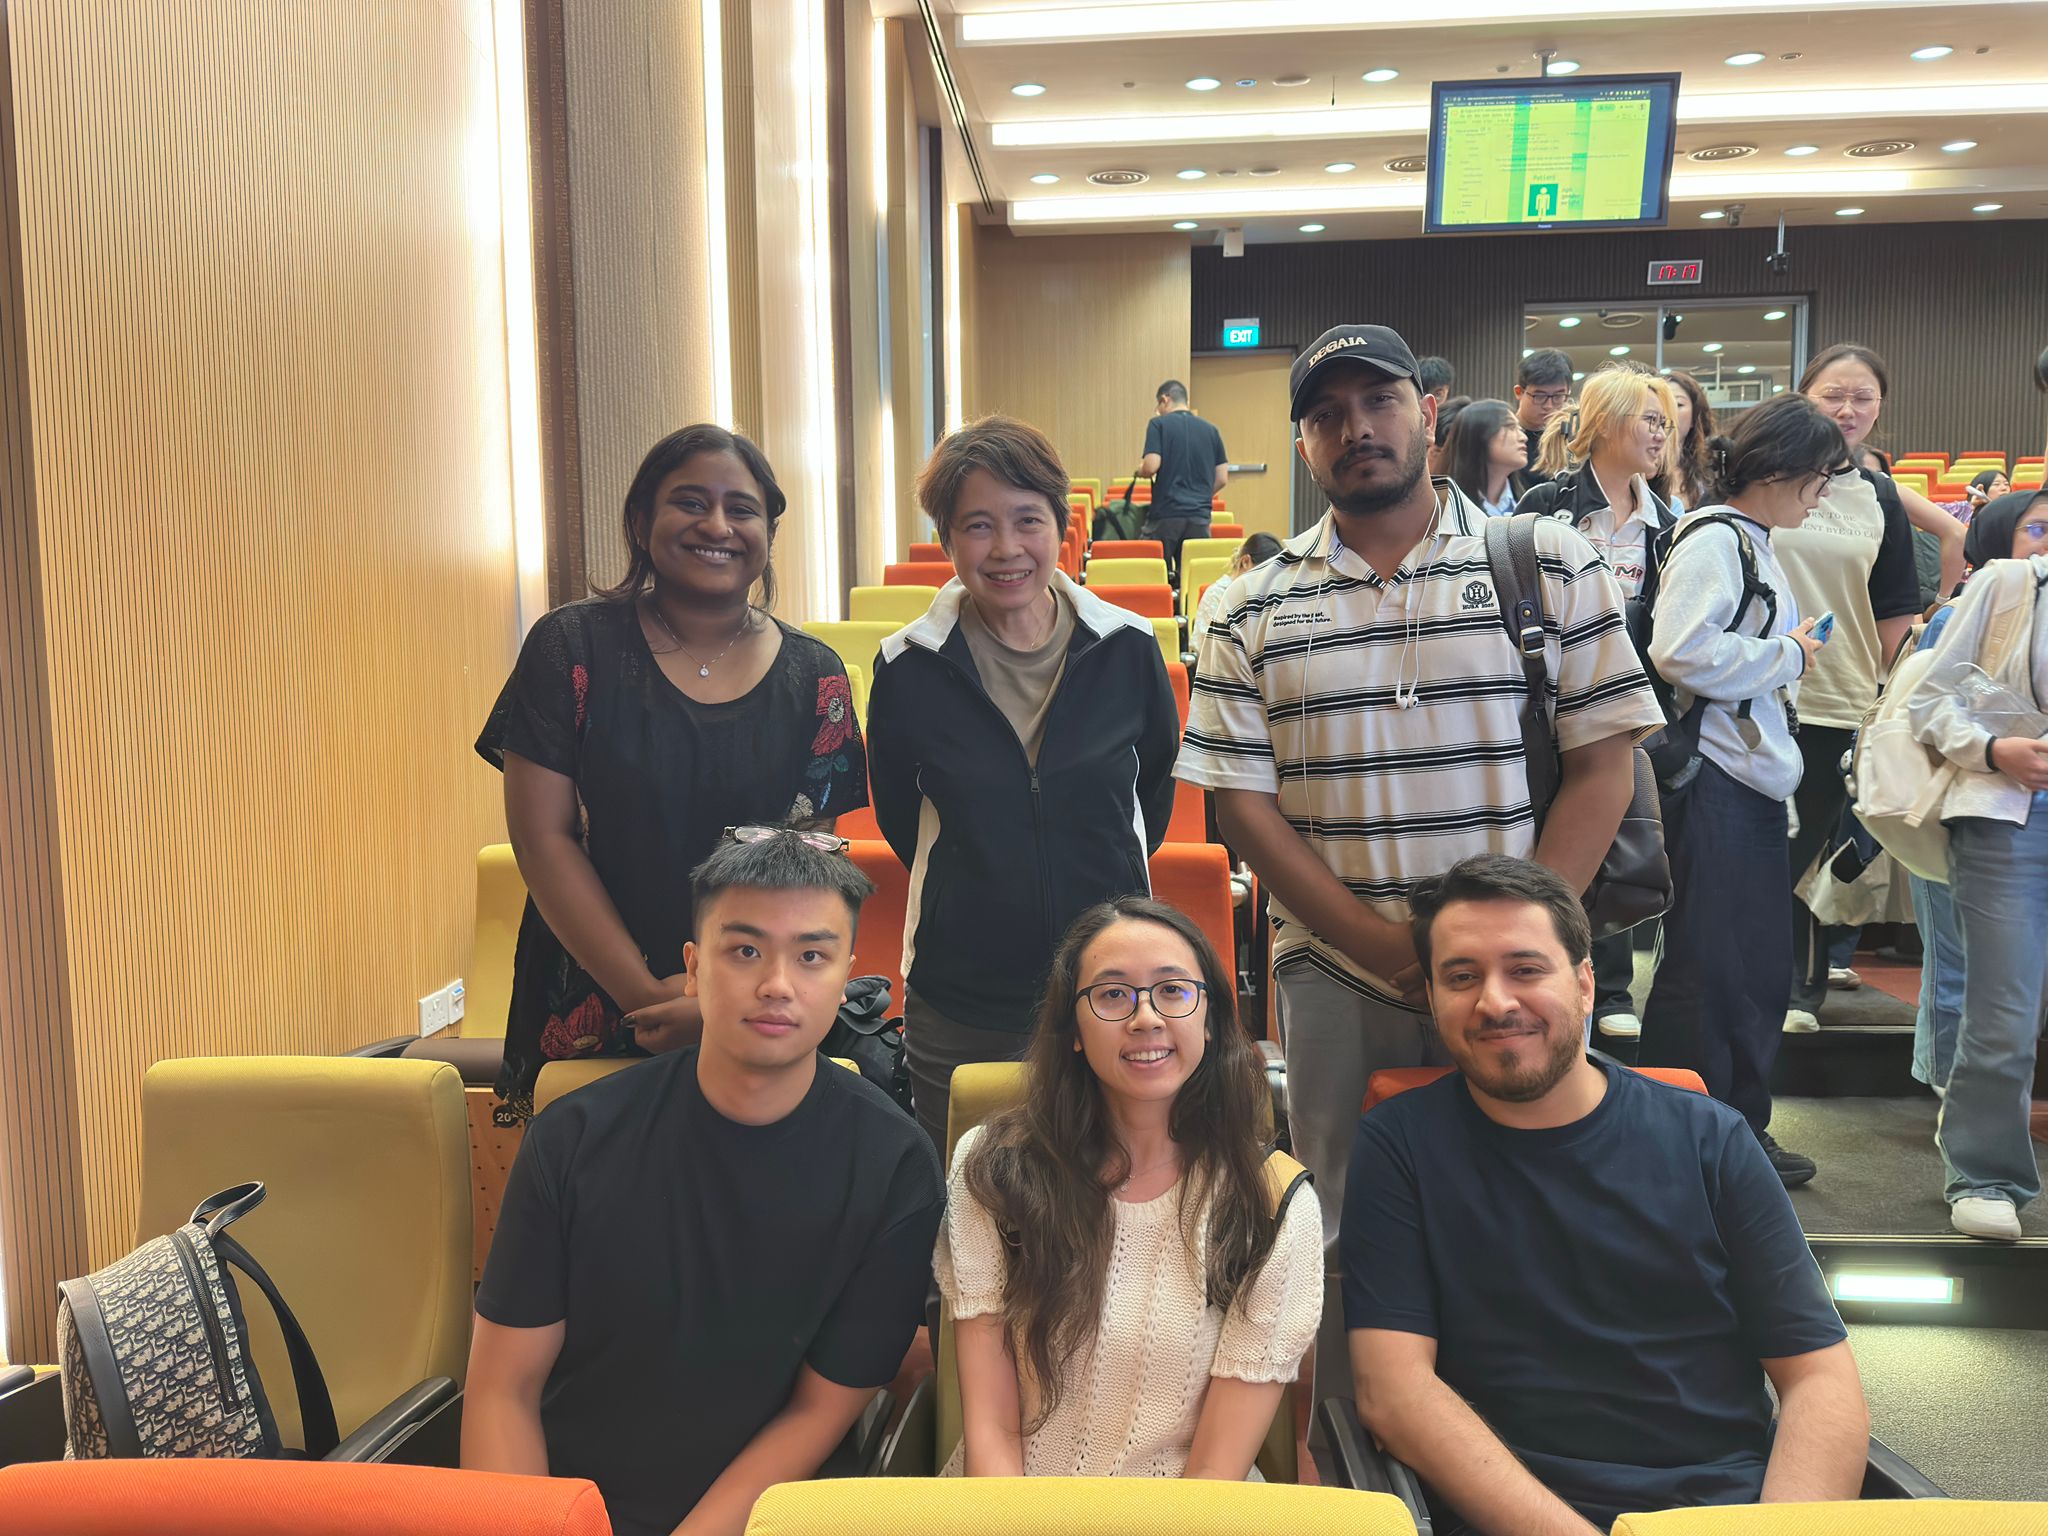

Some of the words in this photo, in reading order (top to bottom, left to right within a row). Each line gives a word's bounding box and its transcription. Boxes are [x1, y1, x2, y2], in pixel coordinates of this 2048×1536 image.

[1658, 264, 1697, 280] 17:17
[1230, 329, 1253, 343] EXIT
[1308, 337, 1368, 368] DEGAIA
[496, 1112, 512, 1122] 20
